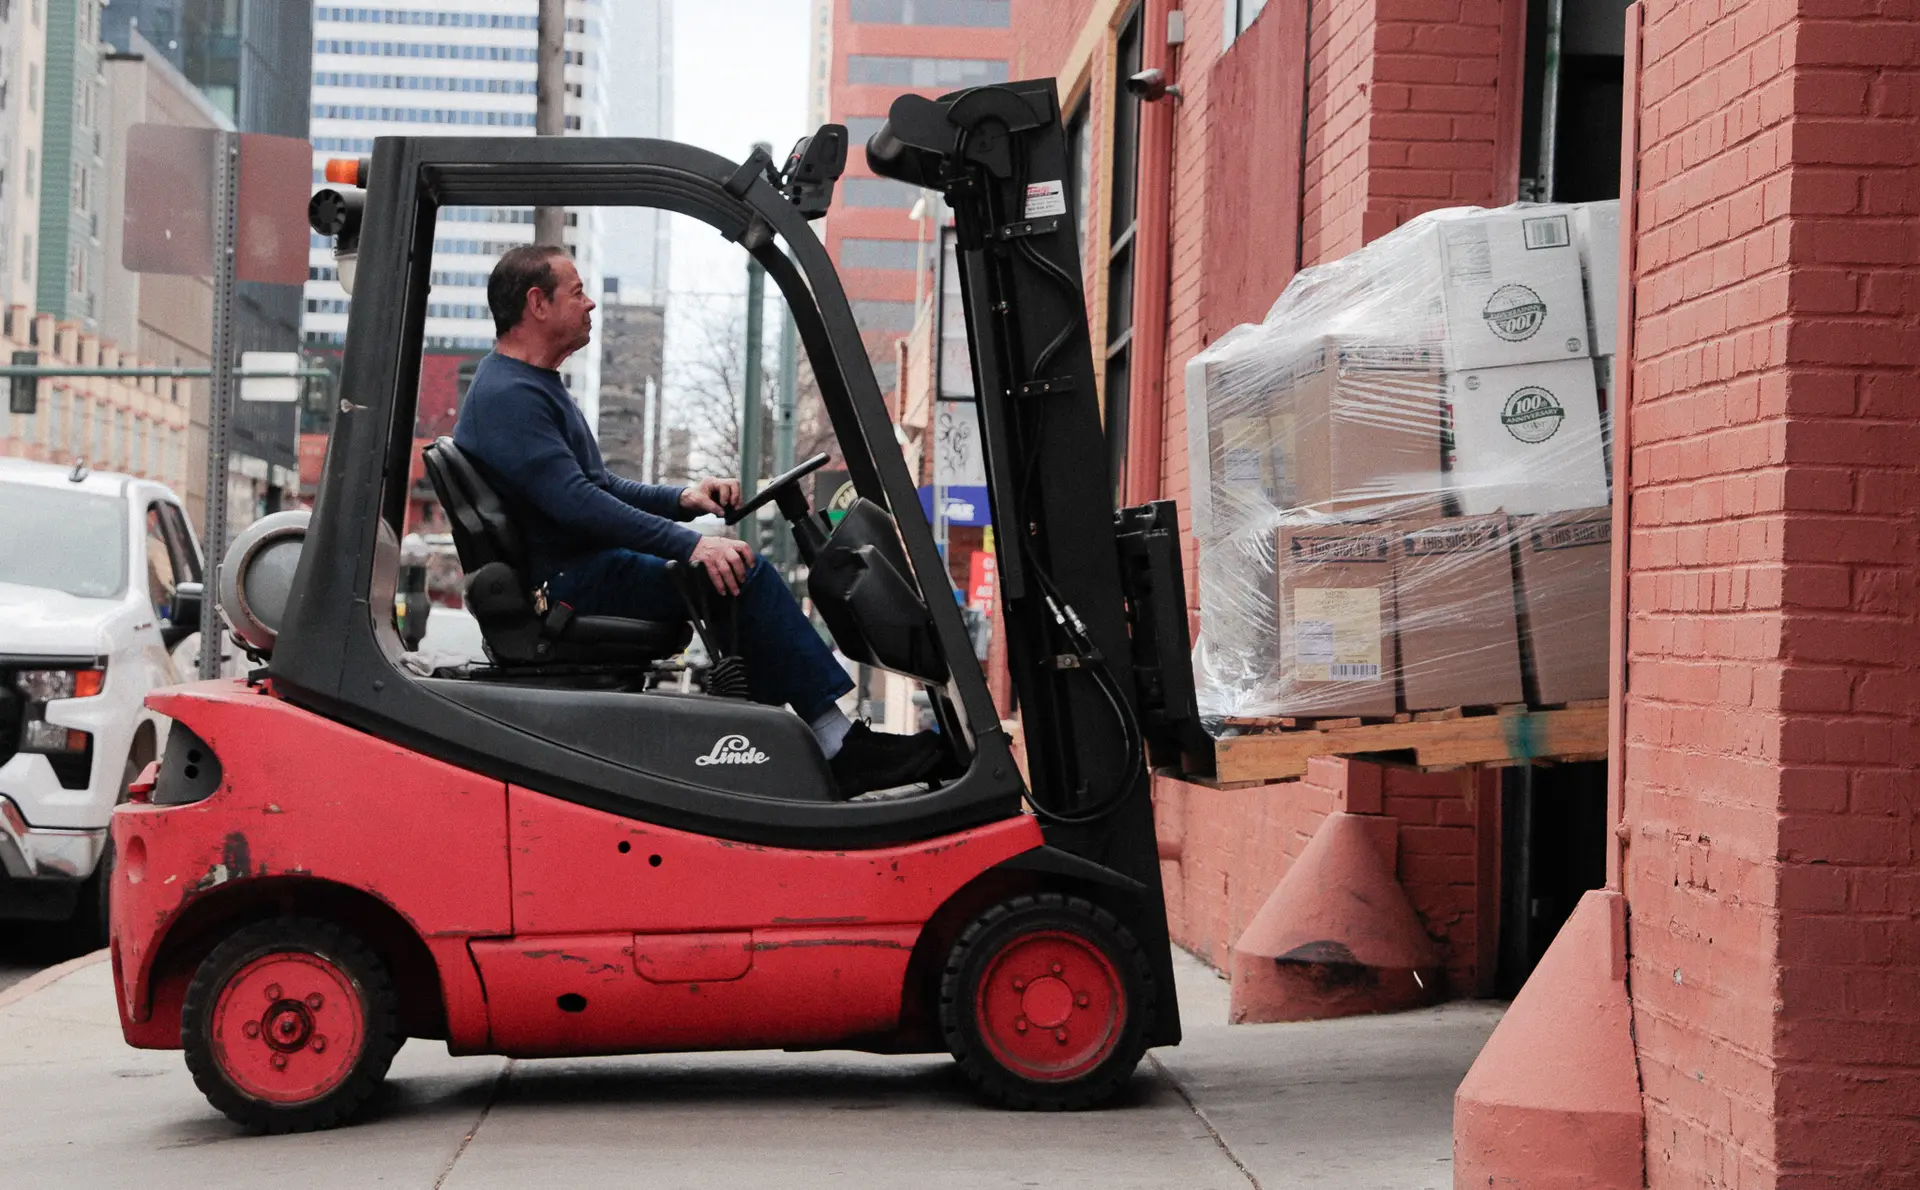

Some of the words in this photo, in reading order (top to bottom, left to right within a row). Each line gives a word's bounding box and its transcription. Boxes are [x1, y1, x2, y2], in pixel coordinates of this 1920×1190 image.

[1506, 408, 1558, 424] ANNIVERSARY
[1422, 536, 1443, 549] THIS
[1445, 534, 1468, 548] SIDE
[1469, 532, 1482, 547] UP
[1550, 529, 1572, 545] THIS
[1573, 526, 1596, 542] SIDE
[1598, 524, 1612, 539] UP
[1310, 543, 1331, 557] THIS
[1356, 543, 1371, 557] UP
[695, 734, 770, 766] Linde
